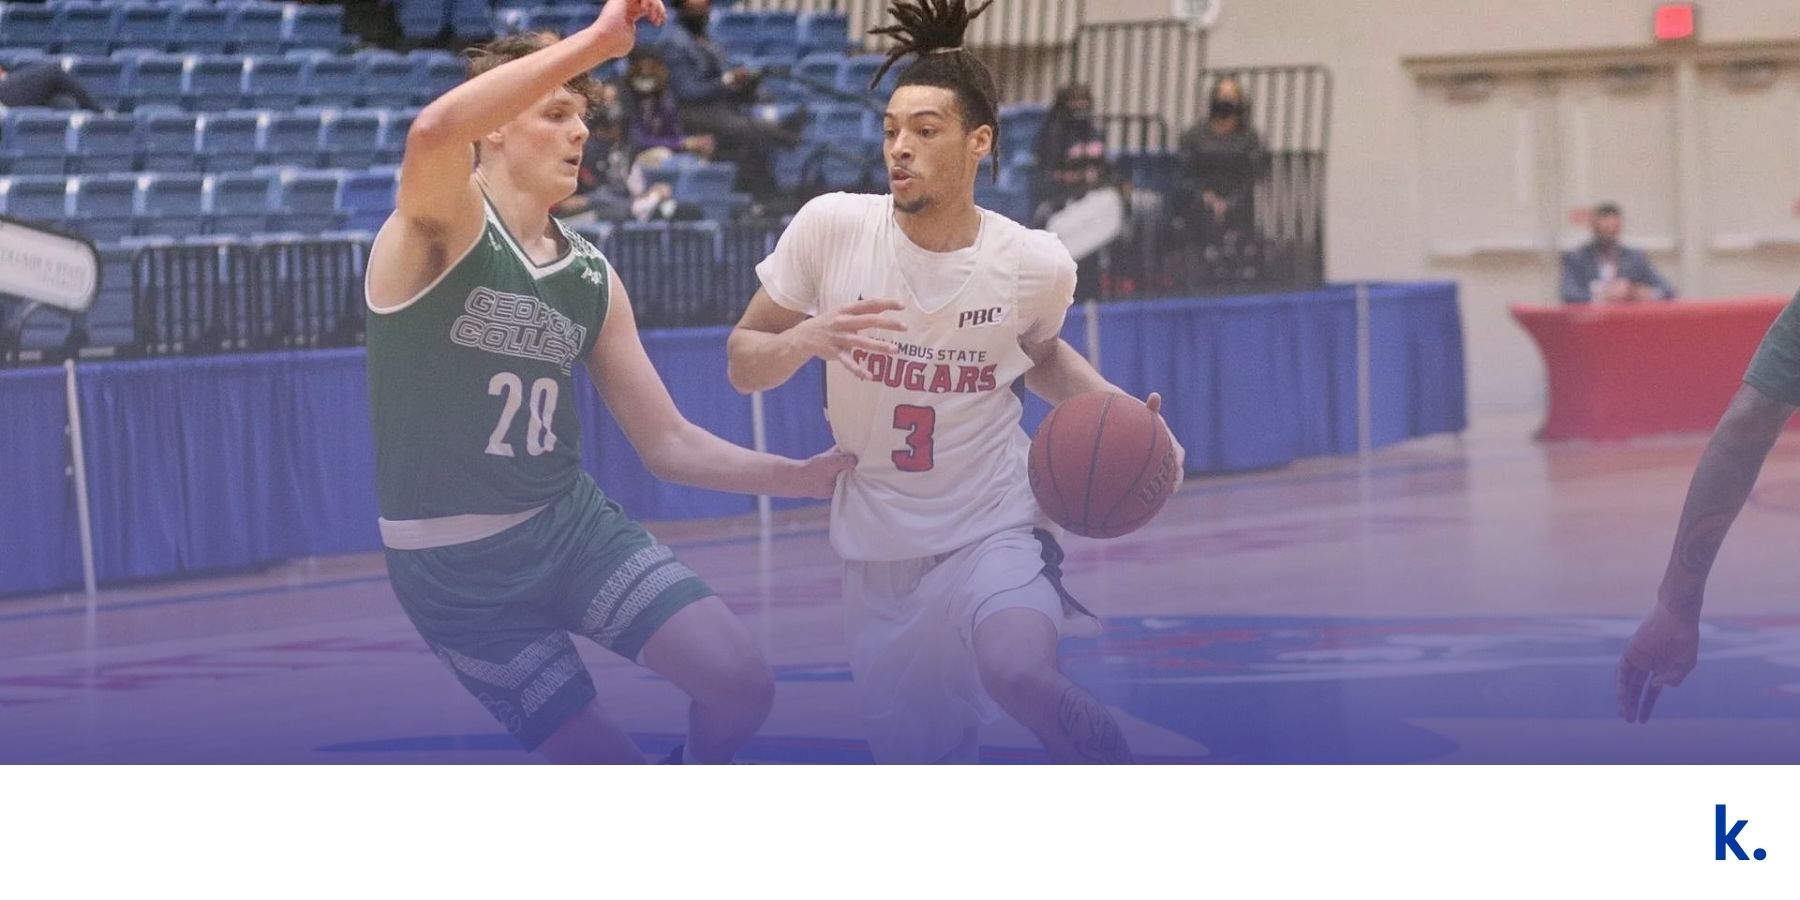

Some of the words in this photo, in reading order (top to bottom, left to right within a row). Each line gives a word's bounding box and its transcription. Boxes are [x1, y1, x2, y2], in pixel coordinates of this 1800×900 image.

[450, 315, 576, 376] COLLE
[958, 307, 1002, 328] PBC
[937, 349, 988, 363] STATE
[484, 371, 559, 457] 20
[891, 403, 936, 472] 3
